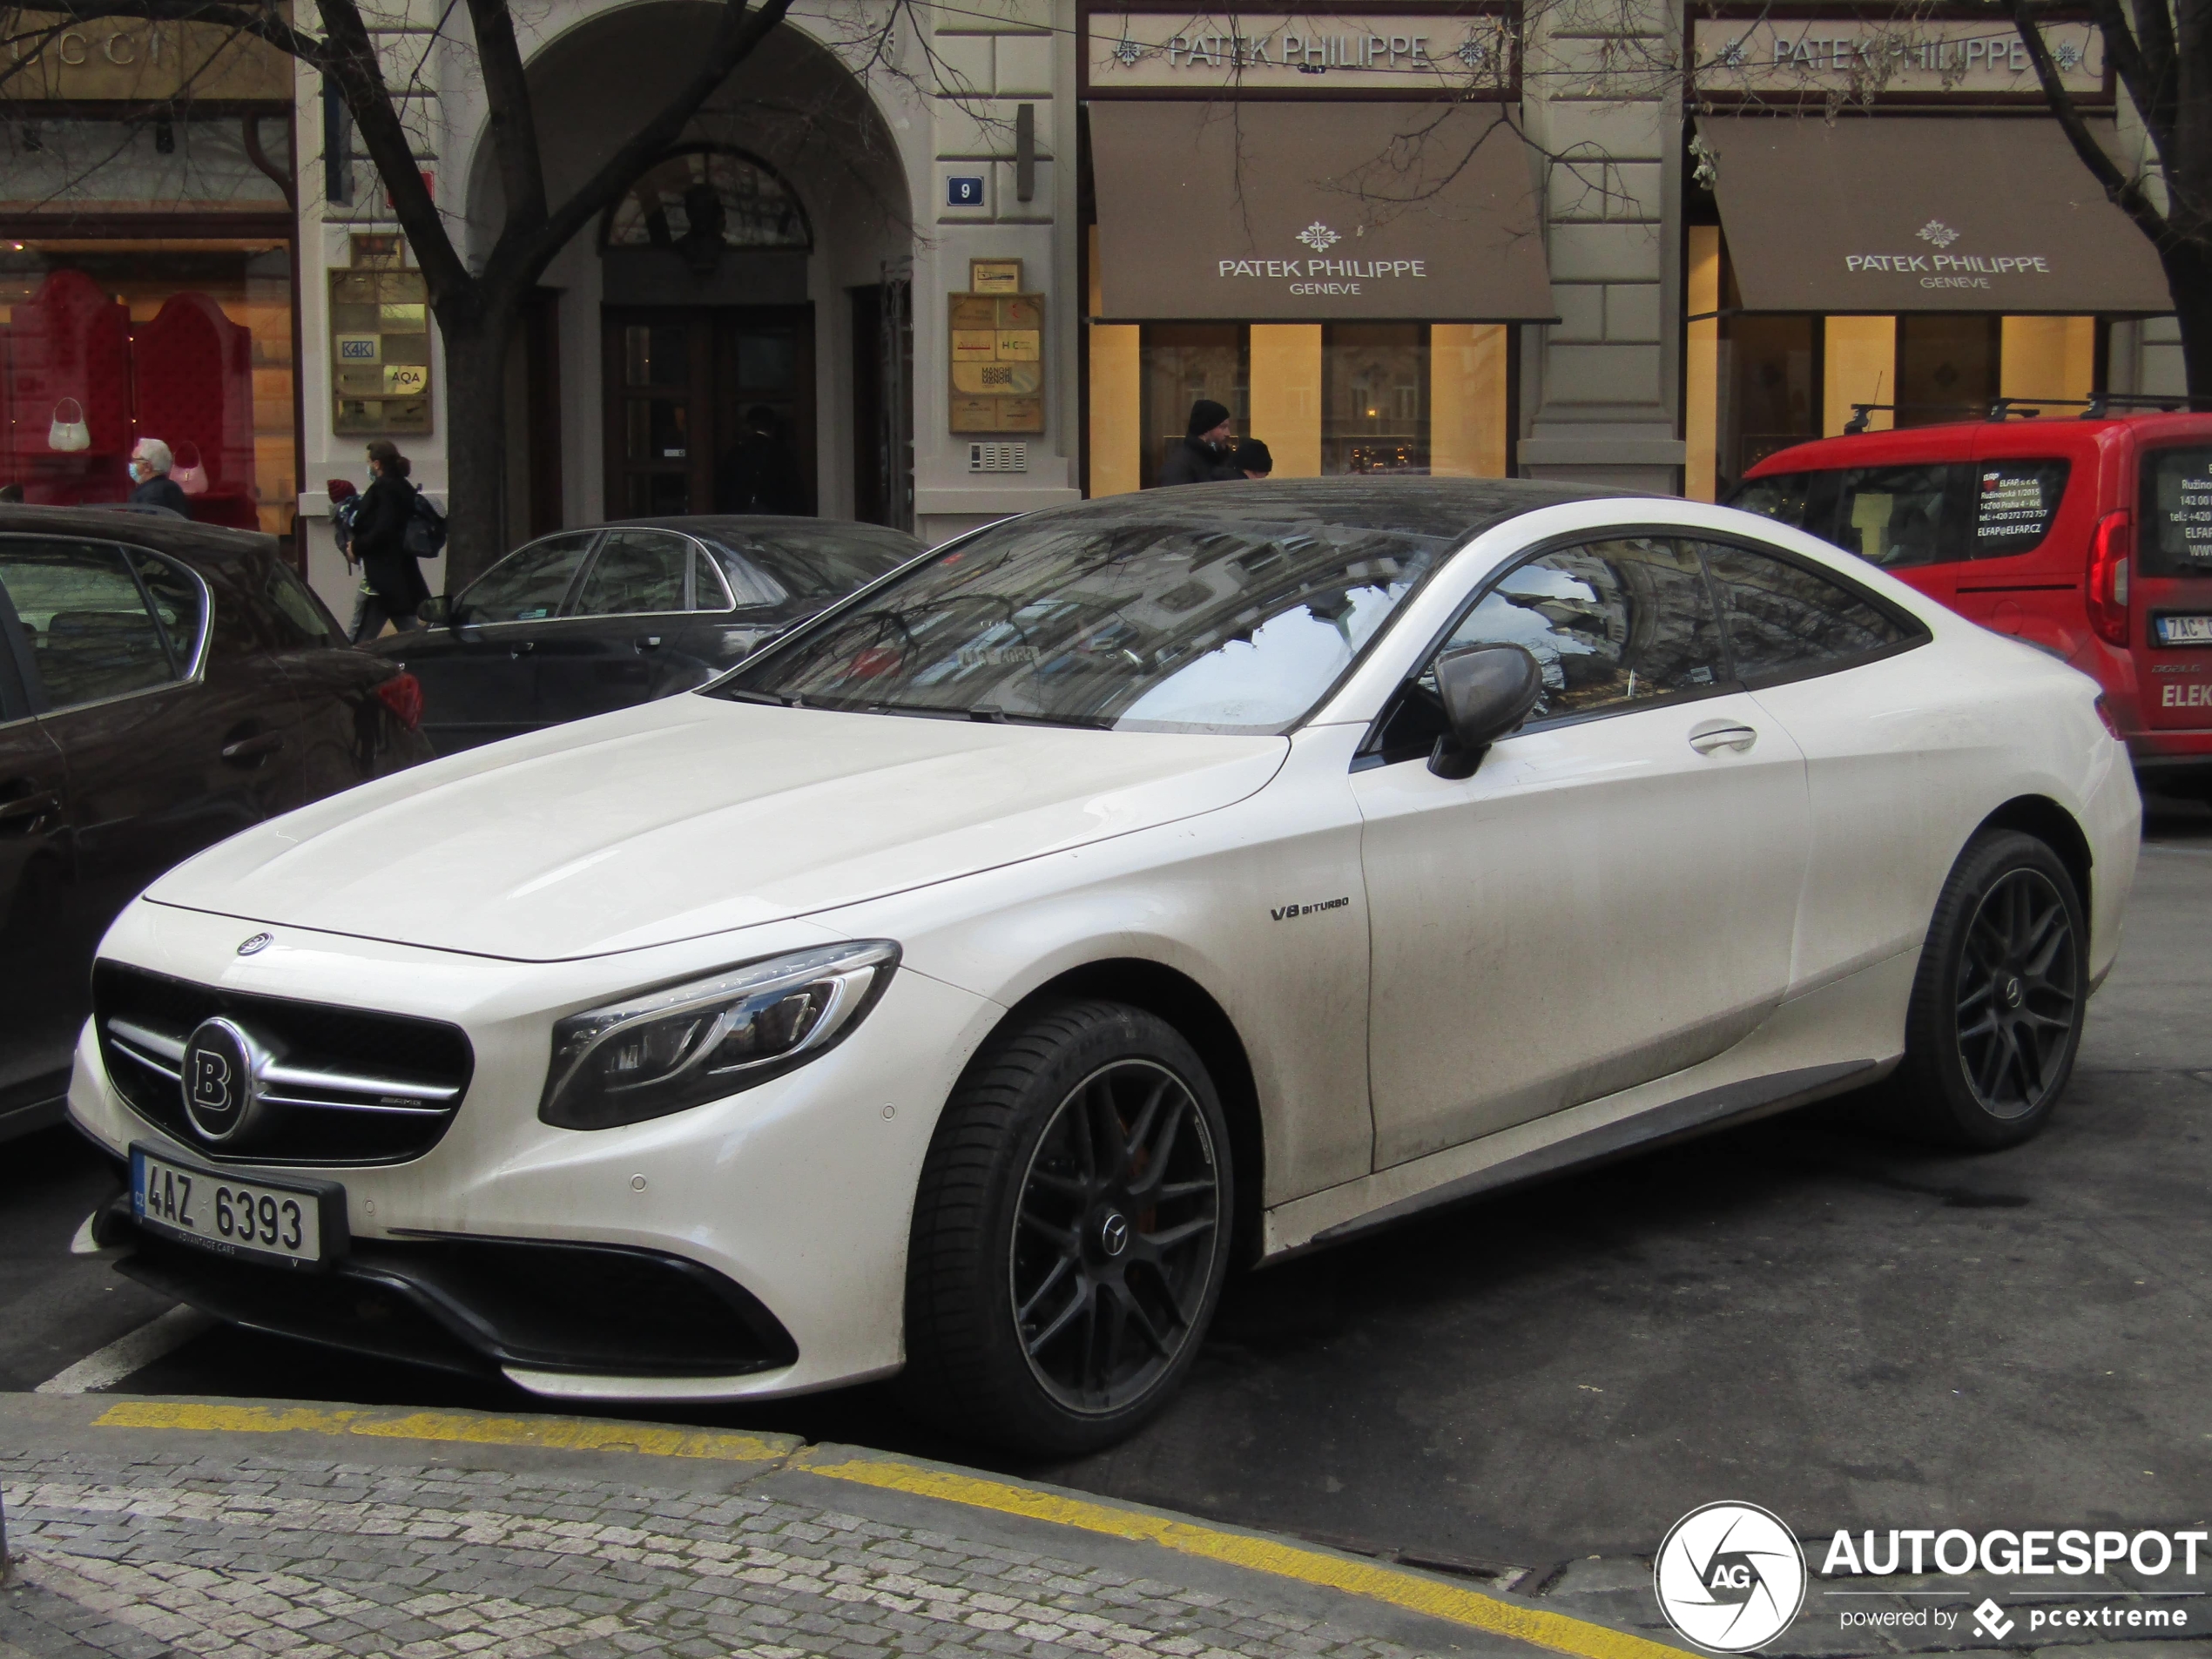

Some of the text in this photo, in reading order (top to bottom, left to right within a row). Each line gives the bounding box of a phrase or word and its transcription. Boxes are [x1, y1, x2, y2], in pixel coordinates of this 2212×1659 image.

[1169, 35, 1428, 67] PATEK PHILIPPE
[1772, 38, 1873, 70] PATEK
[961, 184, 970, 199] 9
[1218, 260, 1426, 278] PATEK PHILIPPE
[1845, 255, 2050, 273] PATEK PHILIPPE
[1289, 283, 1361, 295] GENEVE
[1919, 277, 1991, 289] GENEVE
[391, 372, 421, 384] AQA
[2180, 496, 2196, 505] 142
[2197, 496, 2209, 505] 00
[1992, 511, 2008, 520] +420
[2008, 510, 2020, 520] 272
[2021, 509, 2034, 519] 772
[2035, 509, 2048, 518] 757
[2170, 511, 2210, 521] tel.: +420
[1978, 523, 2041, 536] ELFAP@ELFAP.CZ
[2161, 685, 2212, 707] ELEK
[1271, 897, 1349, 921] V8 BITURBO
[194, 1049, 232, 1111] B
[135, 1164, 302, 1250] CZ 4AZ 6393
[178, 1232, 235, 1256] ADVANTAGE CARS
